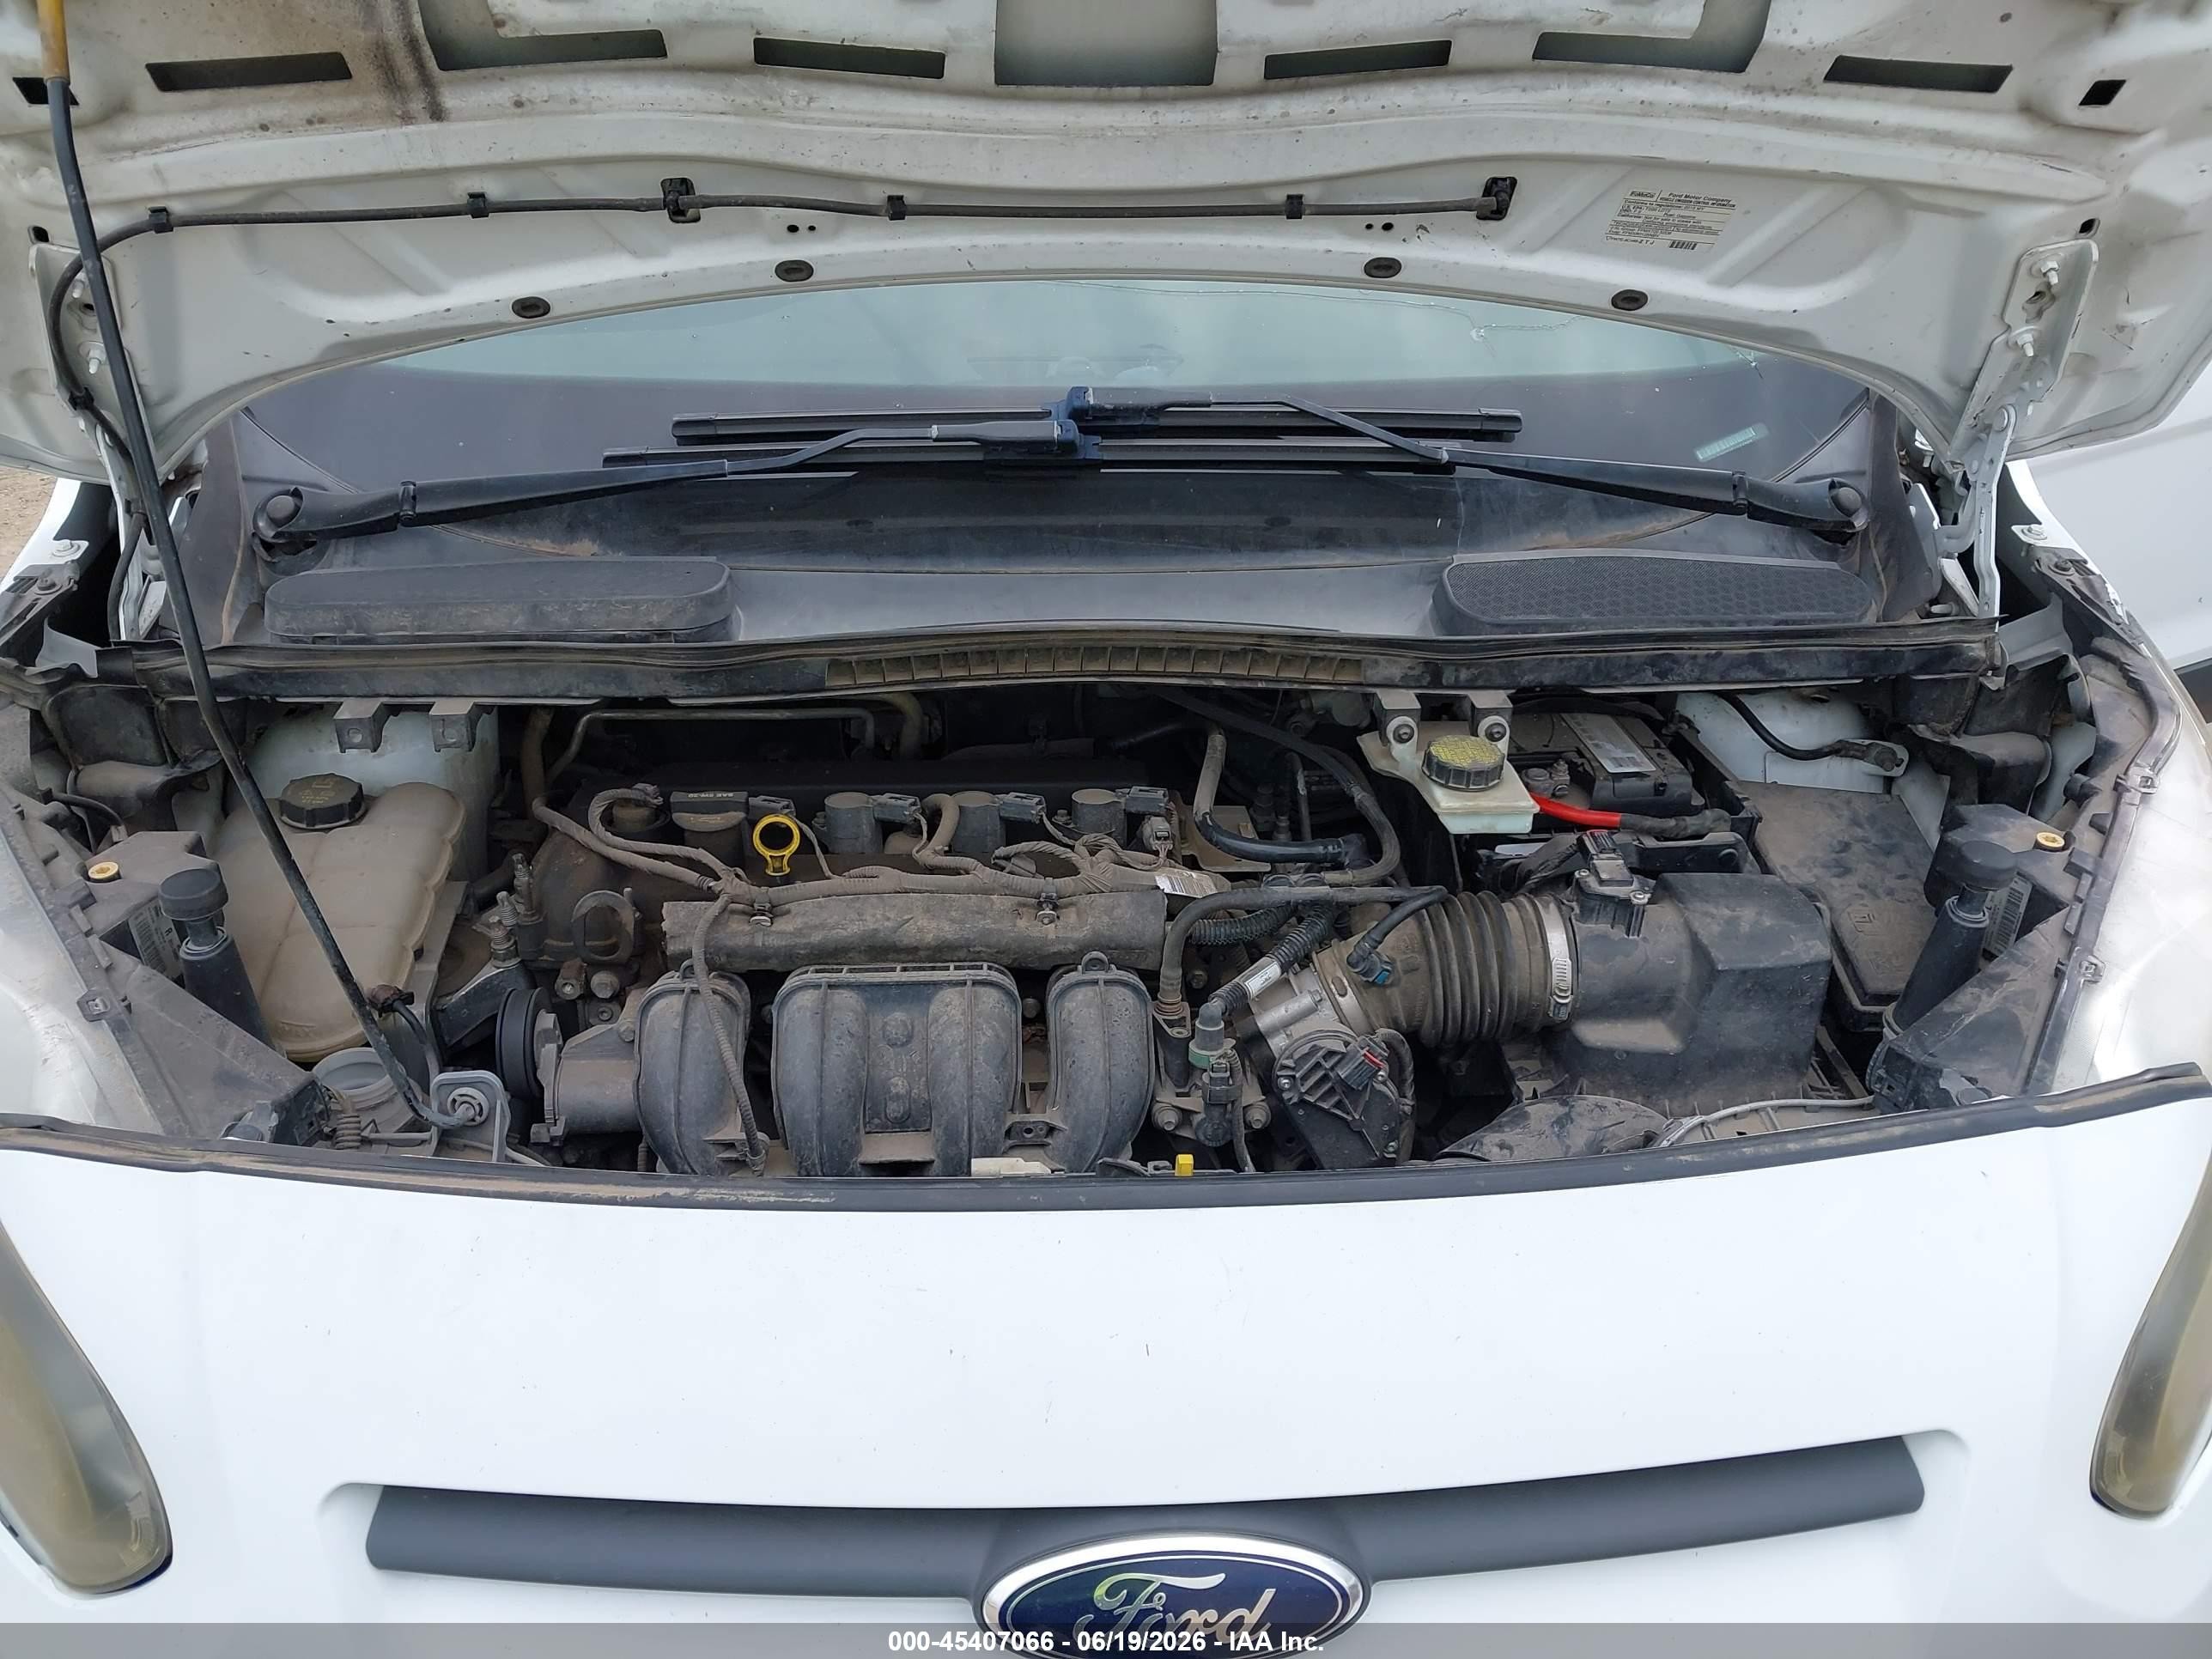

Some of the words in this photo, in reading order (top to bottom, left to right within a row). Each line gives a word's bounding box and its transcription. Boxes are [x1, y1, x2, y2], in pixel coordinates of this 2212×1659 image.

[1703, 197, 1732, 206] Company
[165, 927, 173, 936] R
[1073, 1572, 1277, 1649] Ford
